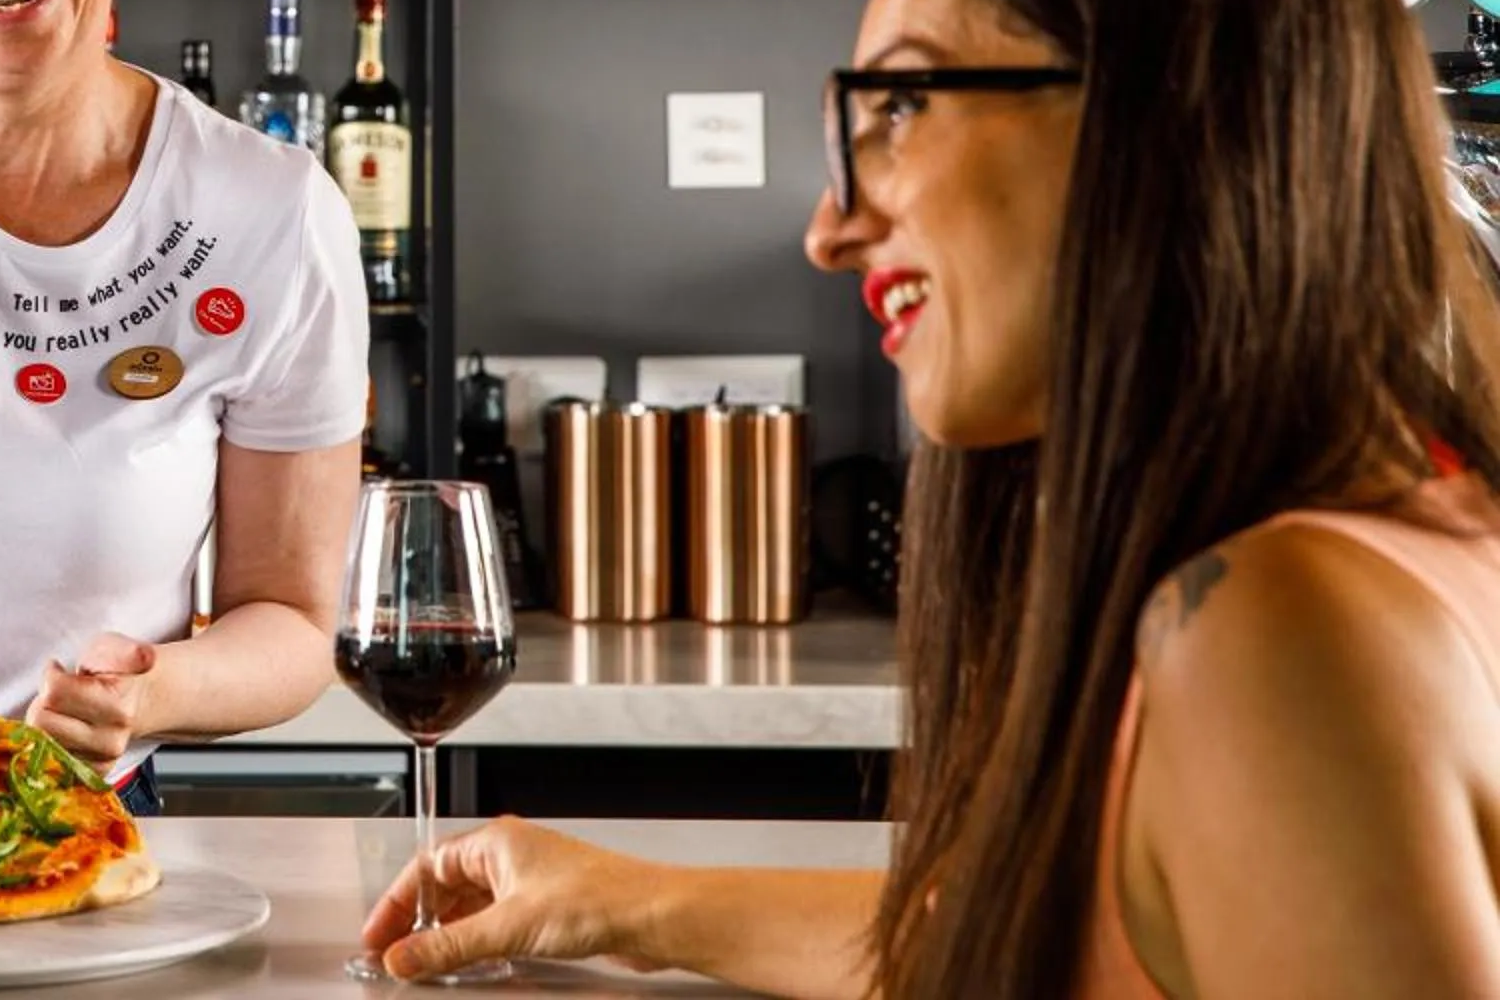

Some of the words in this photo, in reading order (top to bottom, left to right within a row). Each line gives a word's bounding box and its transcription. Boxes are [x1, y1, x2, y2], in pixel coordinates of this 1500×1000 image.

[3, 331, 37, 352] you
[46, 325, 111, 353] really
[118, 281, 180, 333] really
[180, 236, 218, 280] want.
[13, 293, 49, 313] Tell
[59, 298, 80, 313] me
[87, 278, 123, 306] what
[128, 257, 156, 285] you
[156, 219, 194, 258] want.
